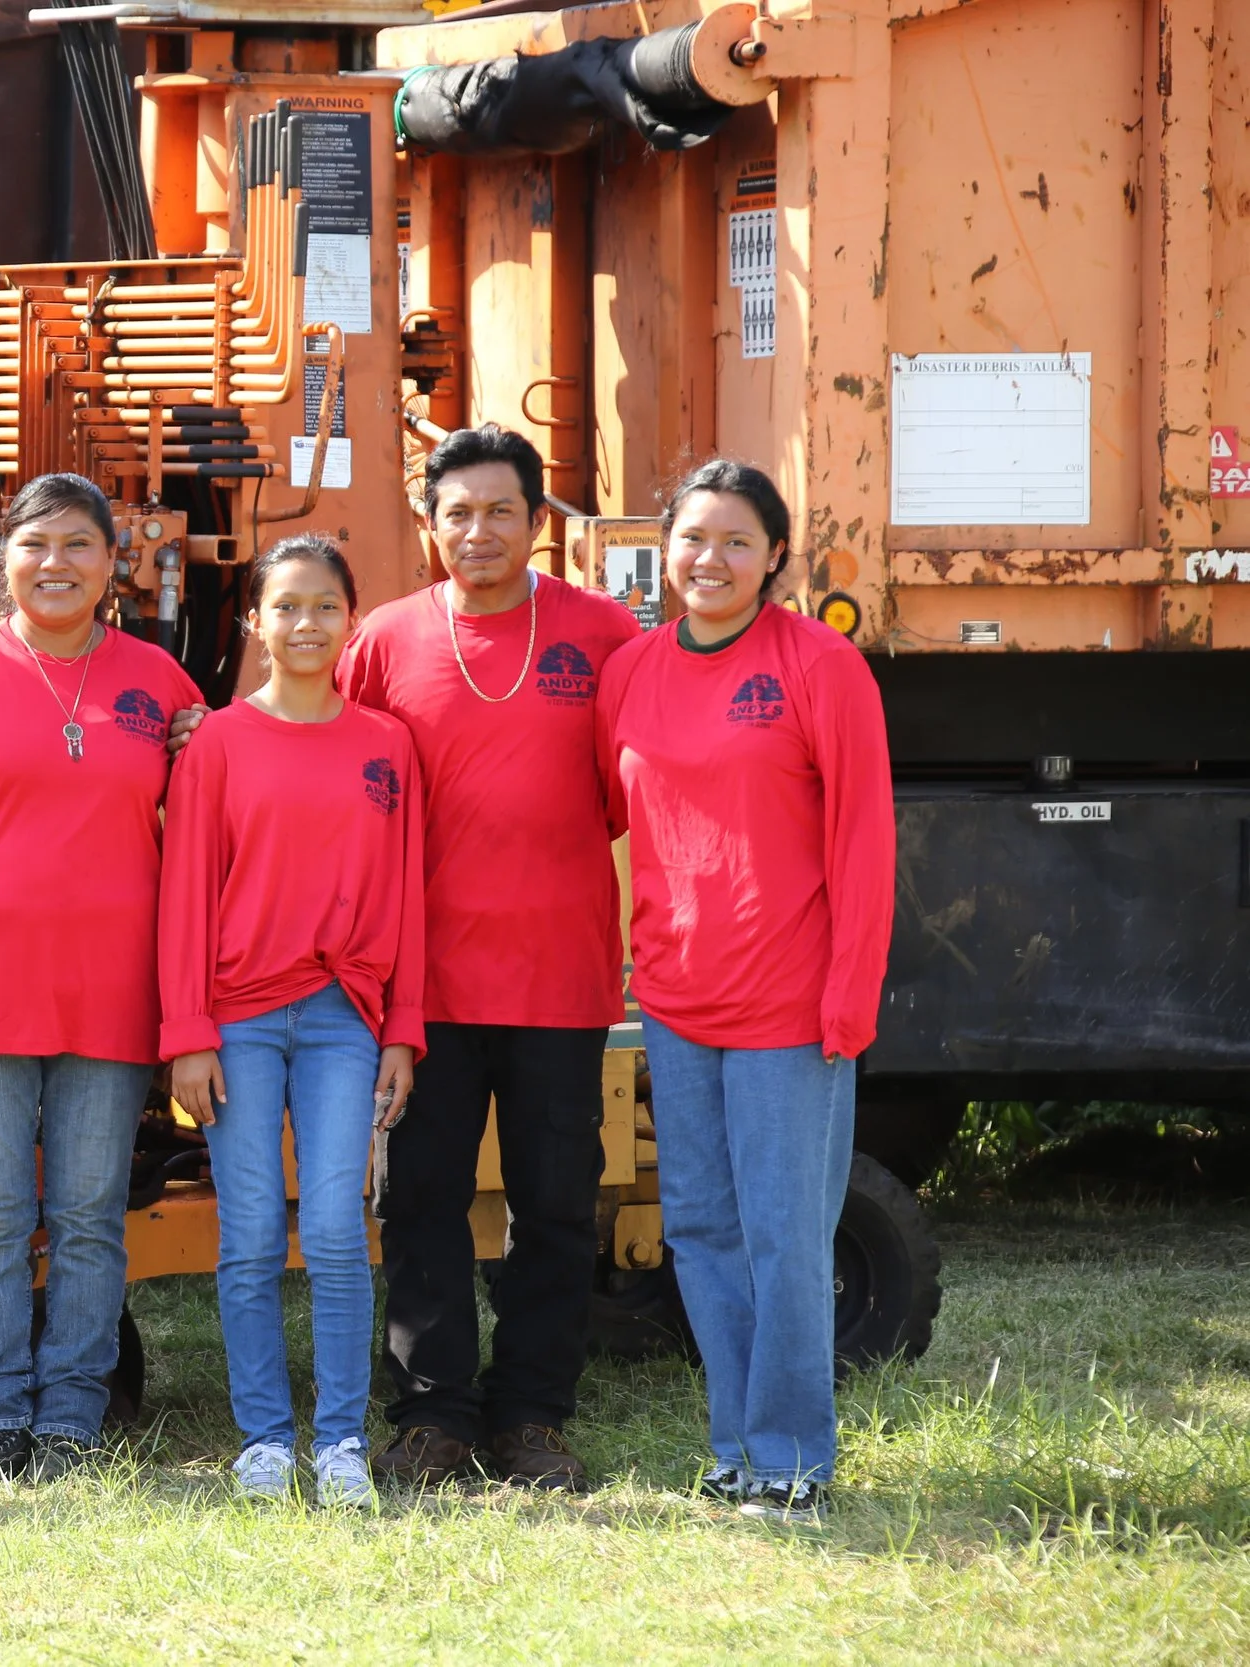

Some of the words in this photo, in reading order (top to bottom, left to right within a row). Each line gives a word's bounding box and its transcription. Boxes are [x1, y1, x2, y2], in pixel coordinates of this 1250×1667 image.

[291, 96, 364, 109] WARNING
[749, 159, 776, 173] WARNIN
[908, 361, 970, 373] DISASTER
[974, 361, 1020, 373] DEBRIS
[1211, 468, 1250, 480] DA
[620, 535, 659, 545] WARNING
[1037, 806, 1073, 819] HYD.
[1081, 805, 1105, 818] OIL
